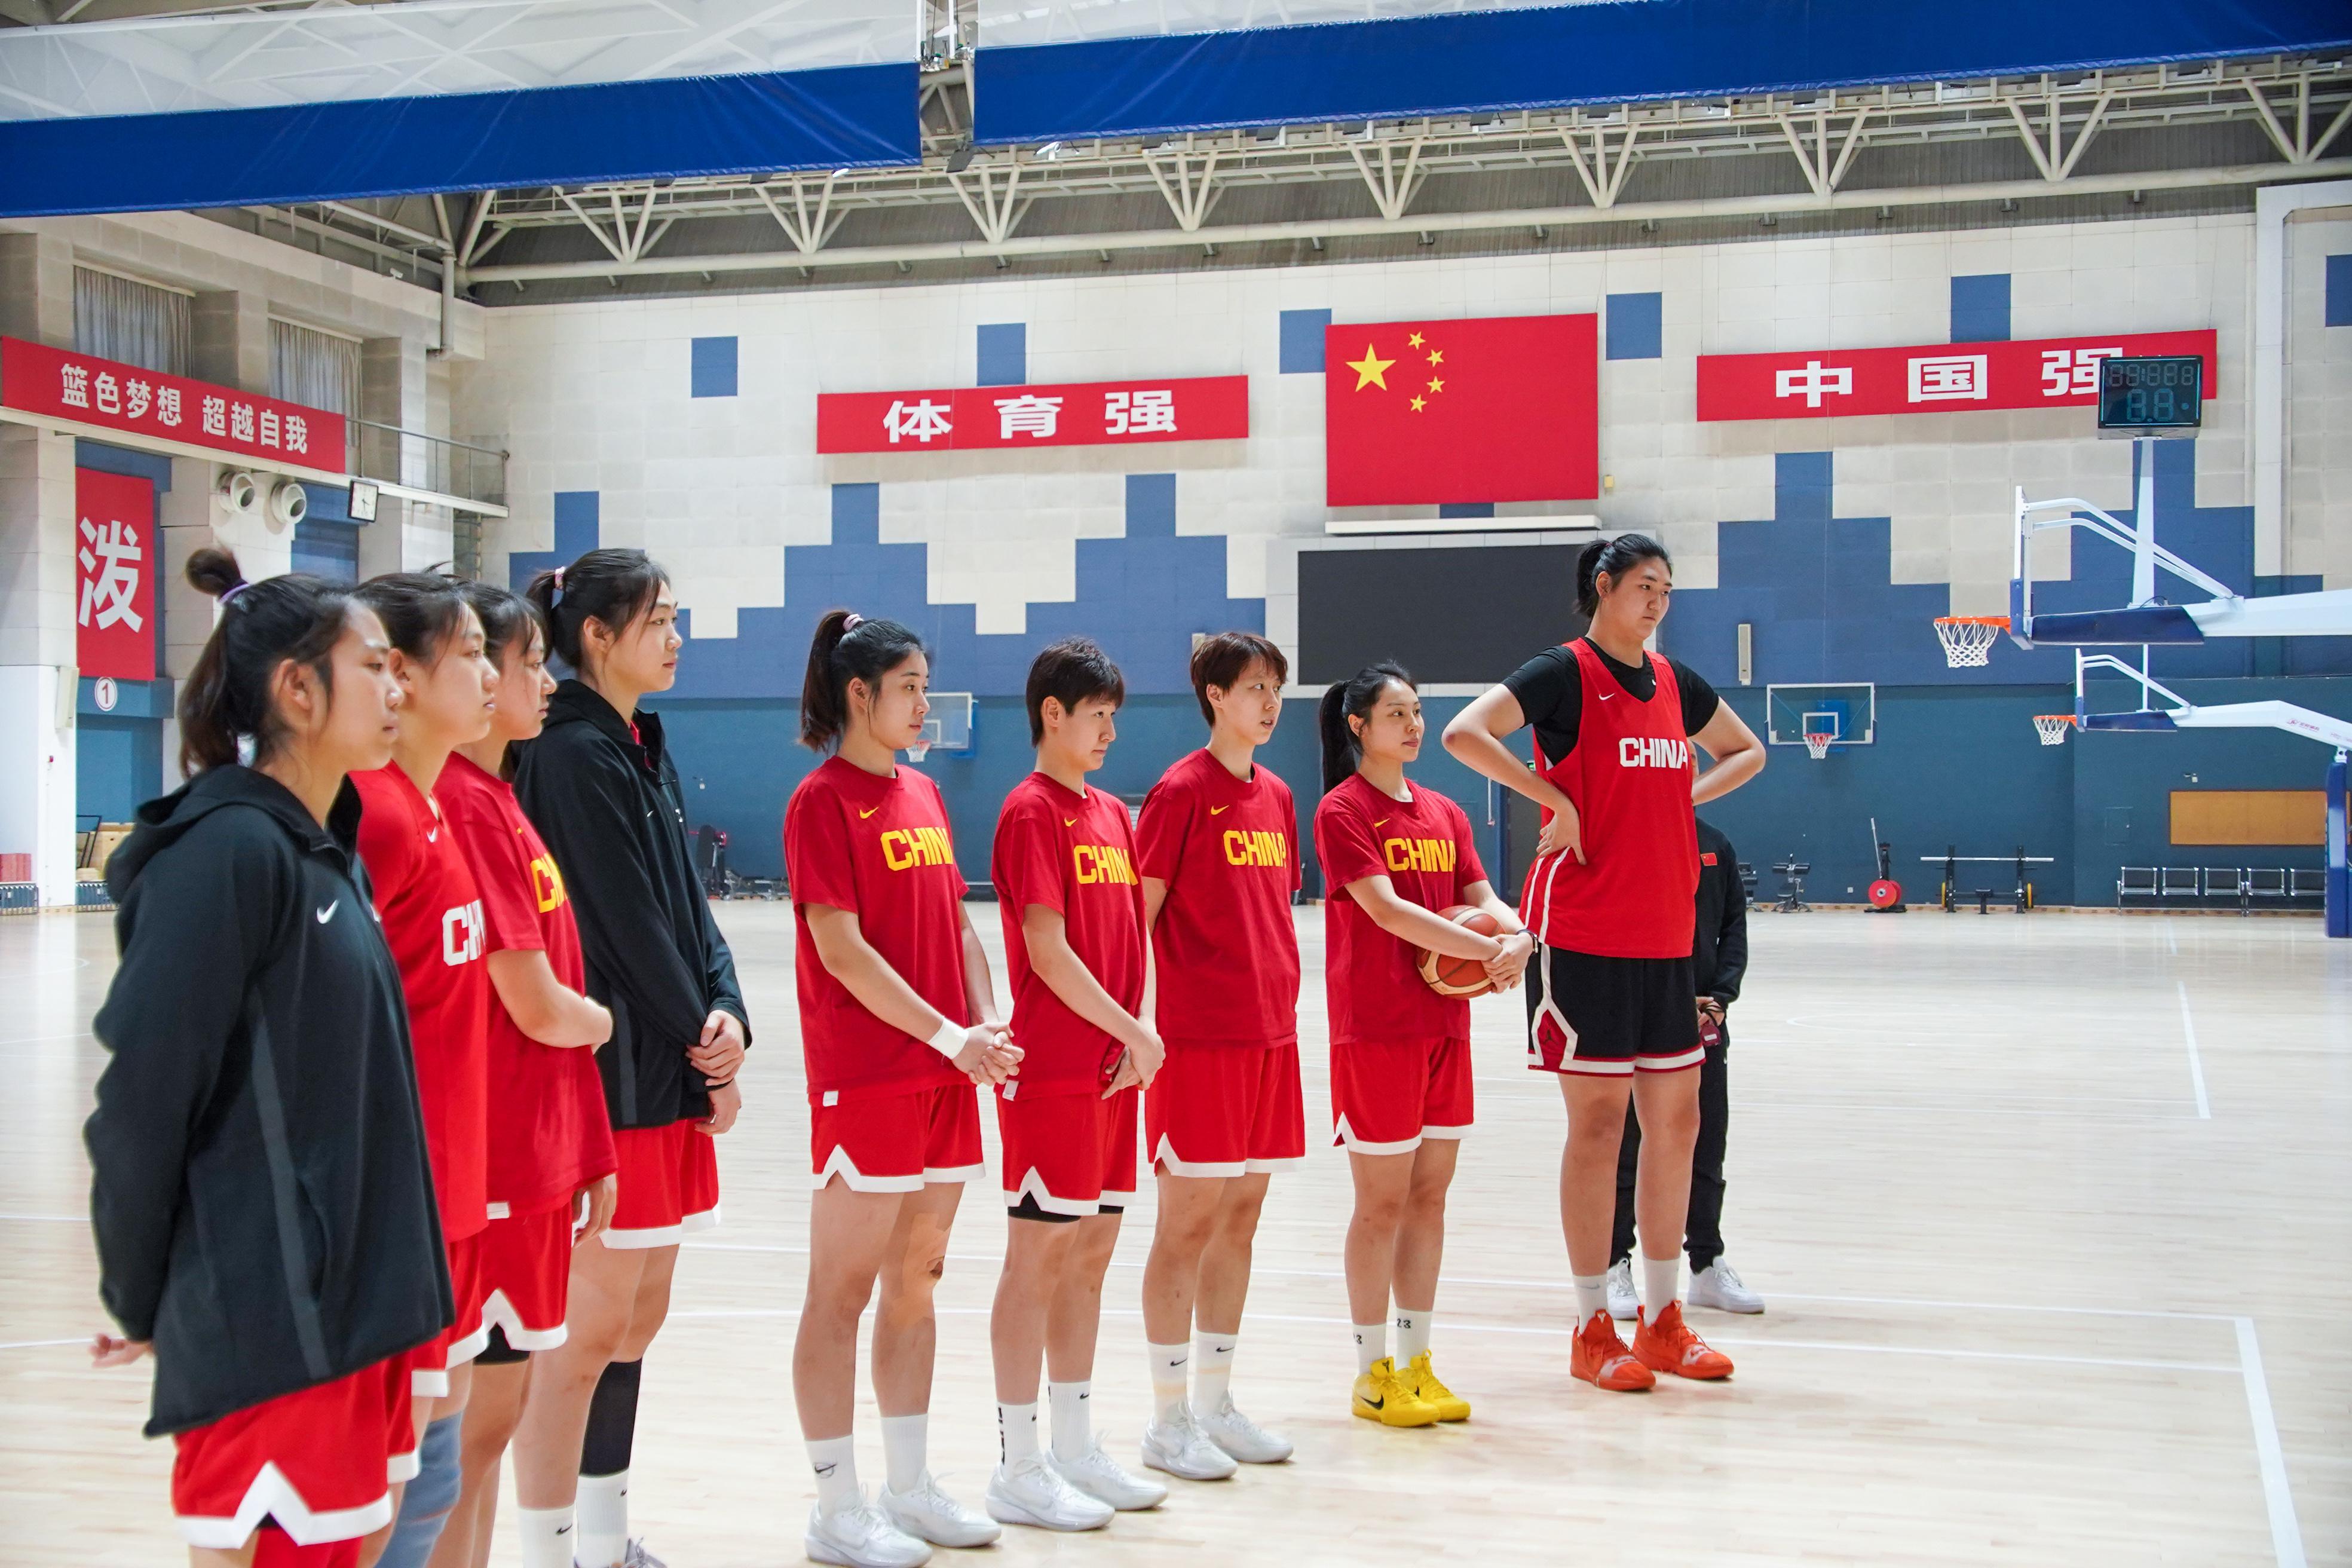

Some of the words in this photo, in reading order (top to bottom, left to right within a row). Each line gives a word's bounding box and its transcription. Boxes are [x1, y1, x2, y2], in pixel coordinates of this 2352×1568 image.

[61, 363, 182, 427] 篮色梦想
[202, 395, 307, 454] 超越自我
[883, 390, 1177, 443] 体育强
[78, 516, 143, 633] 泼
[1619, 737, 1688, 770] CHINA
